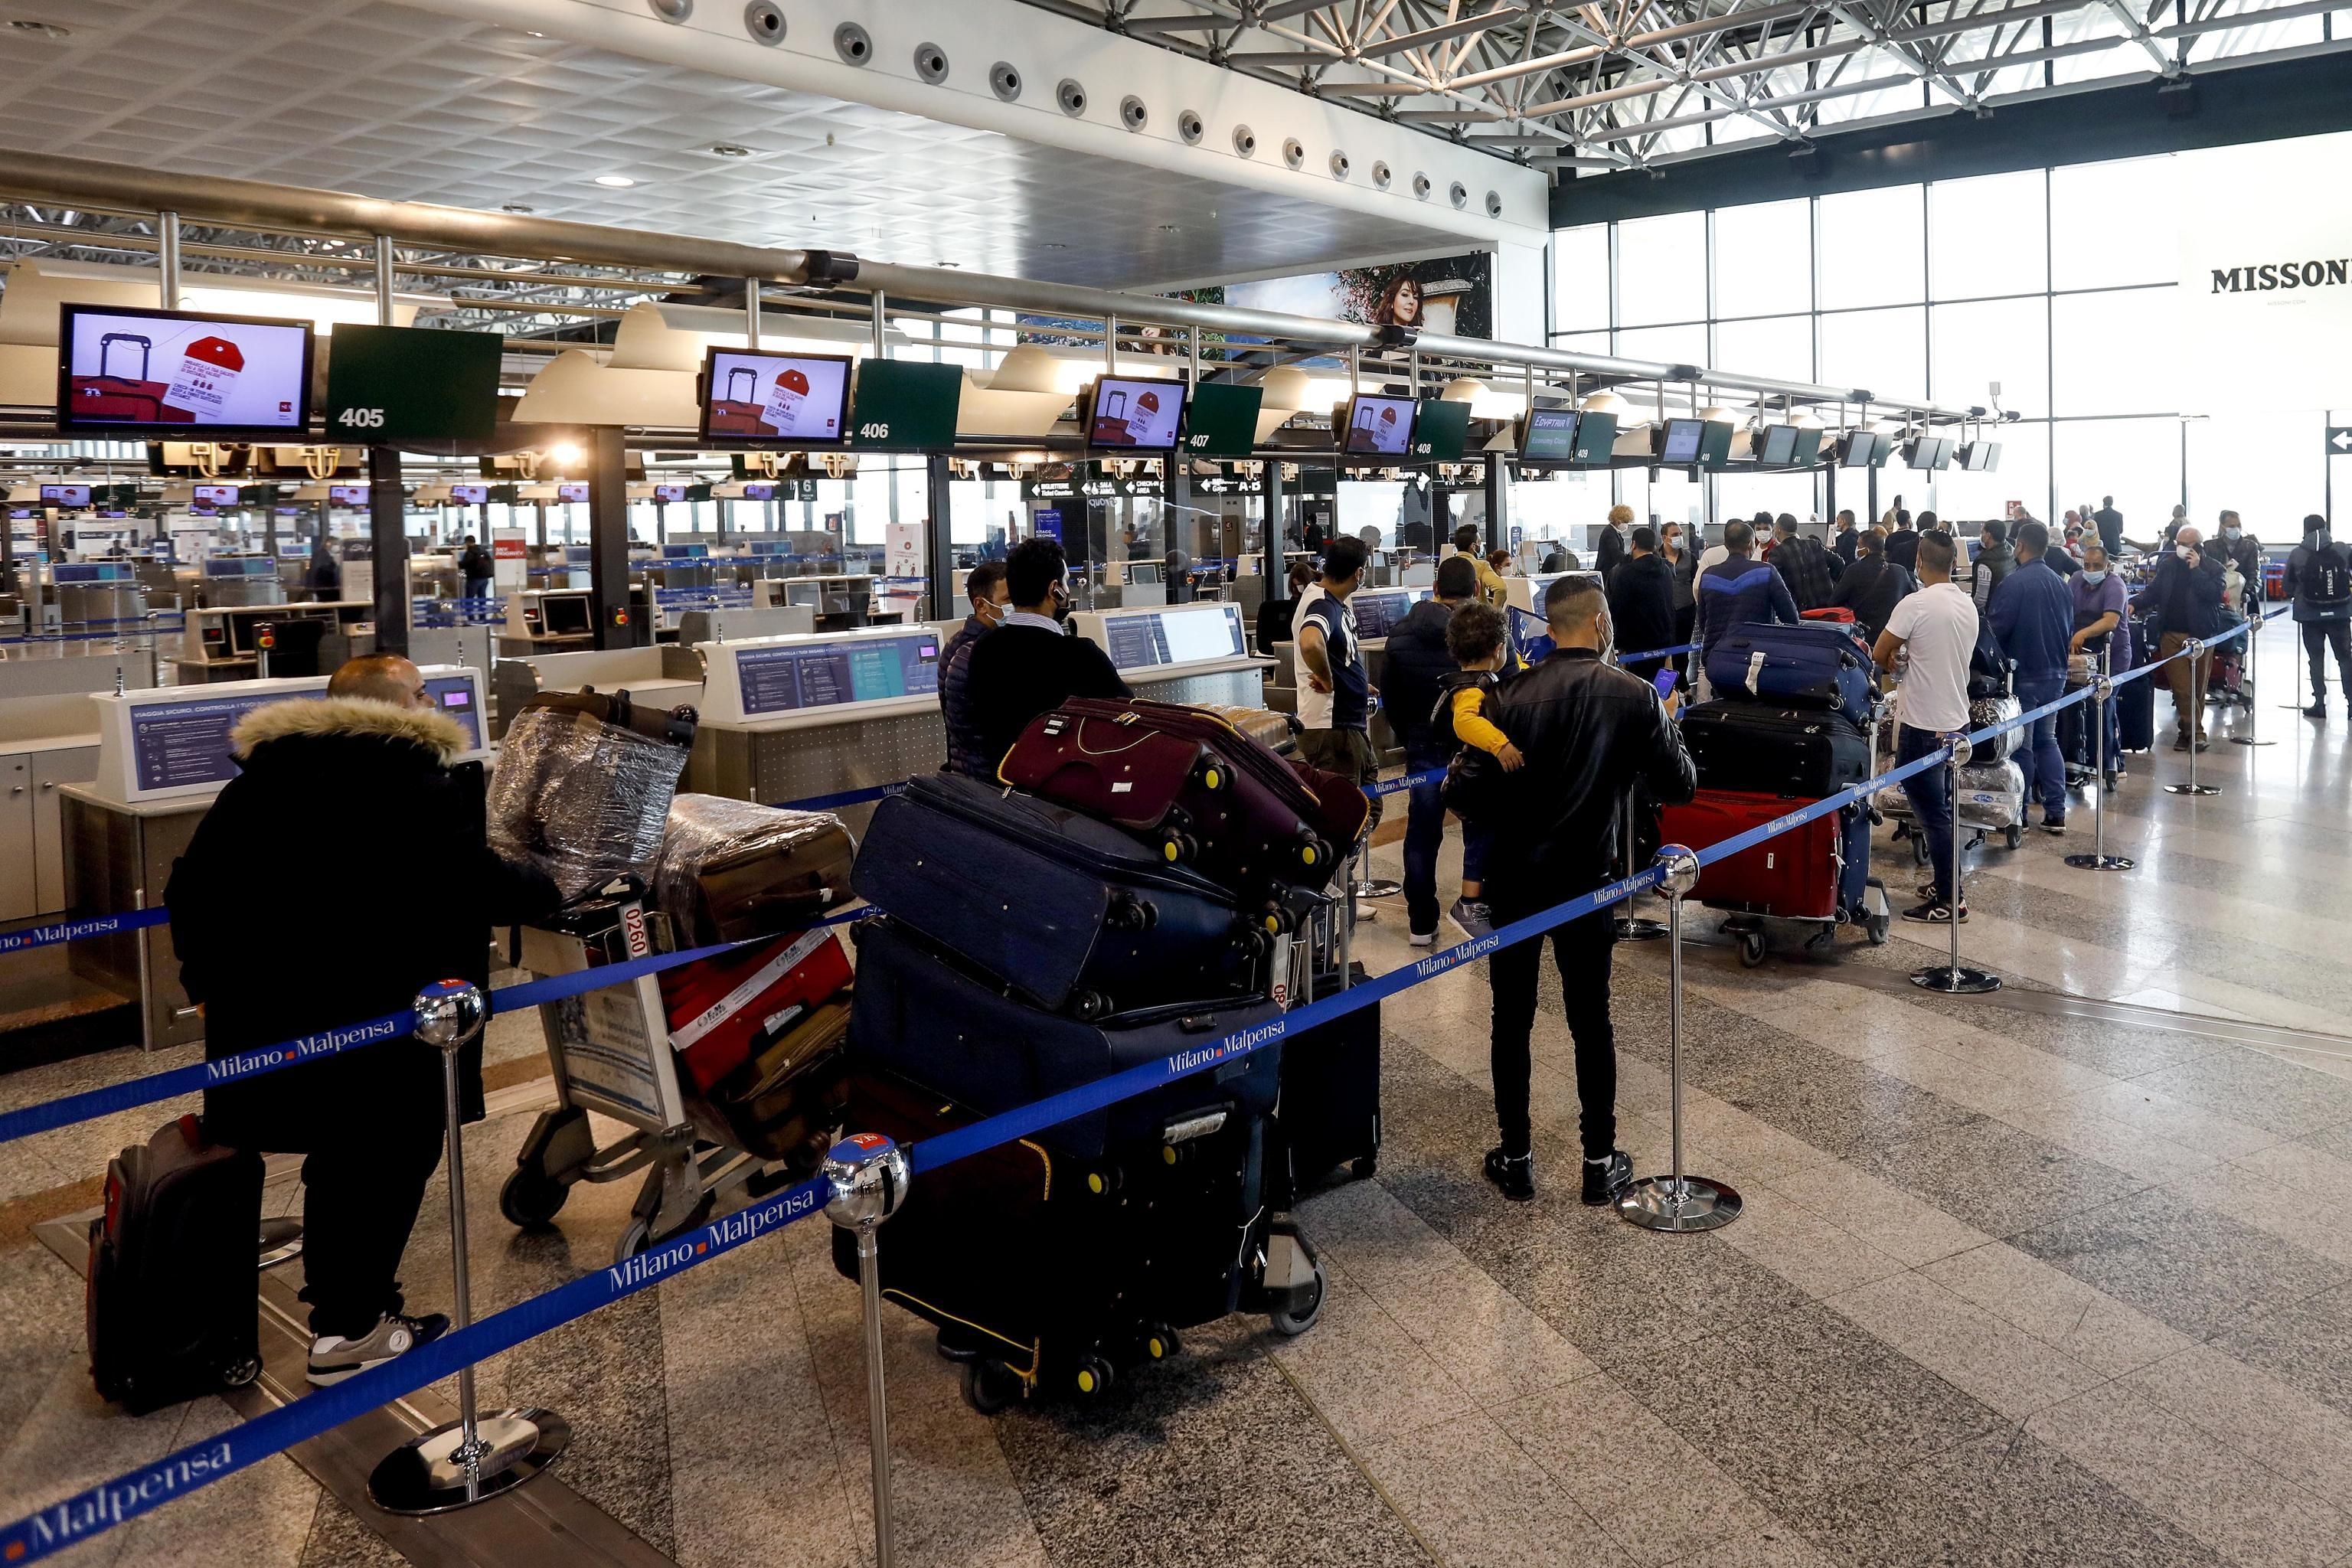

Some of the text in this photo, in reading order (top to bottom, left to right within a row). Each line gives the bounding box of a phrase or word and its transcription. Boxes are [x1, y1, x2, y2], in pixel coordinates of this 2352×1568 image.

[2211, 259, 2352, 293] MISSON
[338, 408, 384, 427] 405
[1534, 416, 1566, 427] EGYPTAIR
[860, 423, 889, 439] 406
[1190, 435, 1209, 447] 407
[1417, 443, 1431, 453] 408
[1577, 449, 1588, 458] 409
[803, 479, 812, 492] 6
[195, 704, 235, 713] CONTROLLA
[882, 785, 906, 795] Milan
[1374, 776, 1426, 793] Milano Malpensa
[1854, 777, 1886, 797] Milano Malpensa
[1767, 812, 1808, 834] Milano Malpensa
[1593, 872, 1655, 905] Milano Malpensa
[33, 919, 118, 943] Malpensa
[626, 909, 646, 952] 0260
[1416, 935, 1498, 978] Milano Malpensa
[207, 1020, 395, 1080] Milano Malpensa
[1168, 1021, 1285, 1075] Milano Malpensa
[608, 1190, 814, 1292] Milano Malpensa
[31, 1442, 231, 1551] Malpensa
